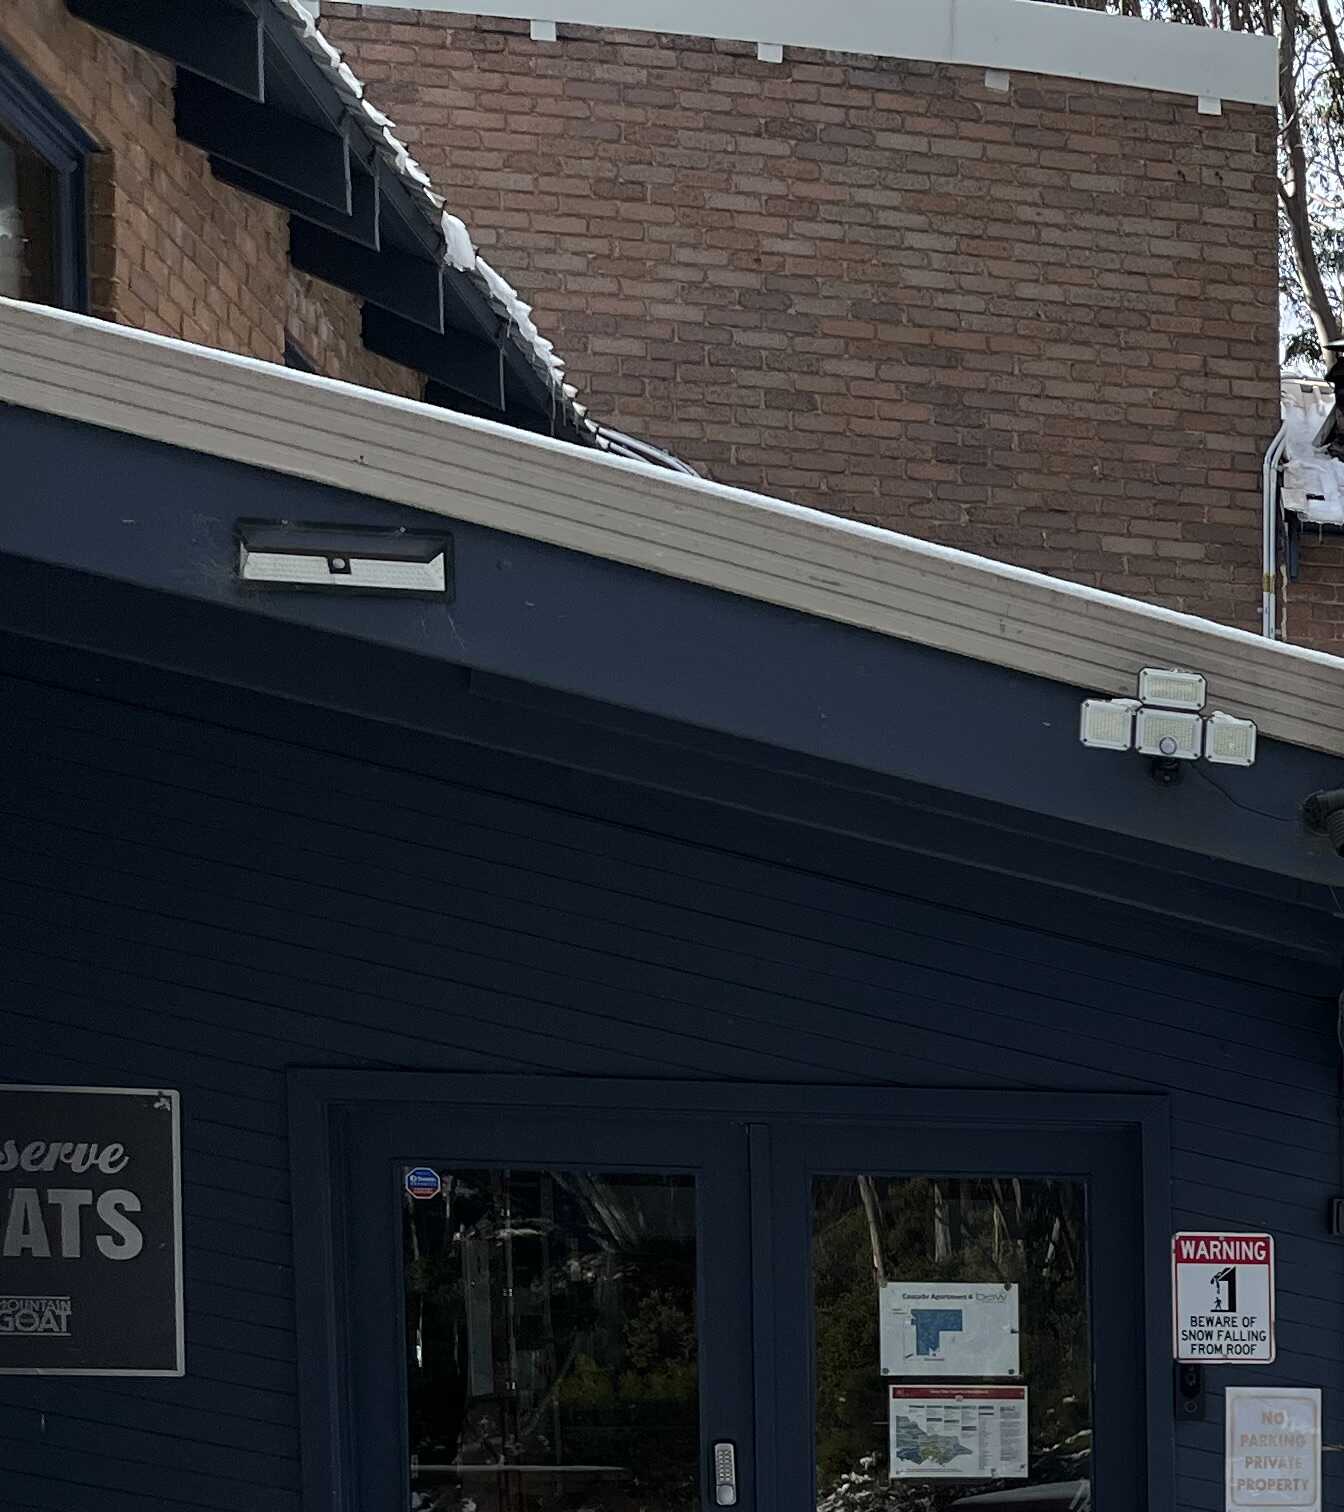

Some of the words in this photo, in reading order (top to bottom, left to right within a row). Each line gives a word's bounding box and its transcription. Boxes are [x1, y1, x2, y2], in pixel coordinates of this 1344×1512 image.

[3, 1188, 143, 1260] ATS
[1181, 1240, 1267, 1261] WARNING
[1190, 1316, 1238, 1328] BEWARE
[1242, 1316, 1257, 1328] OF
[1181, 1330, 1214, 1341] SNOW
[1217, 1330, 1267, 1342] FALLING
[1190, 1344, 1222, 1355] FROM
[1226, 1344, 1257, 1355] ROOF
[1263, 1411, 1285, 1425] NO
[1240, 1433, 1306, 1448] PARKING
[1245, 1455, 1303, 1469] PRIVATE
[1237, 1478, 1310, 1491] PROPERTY
